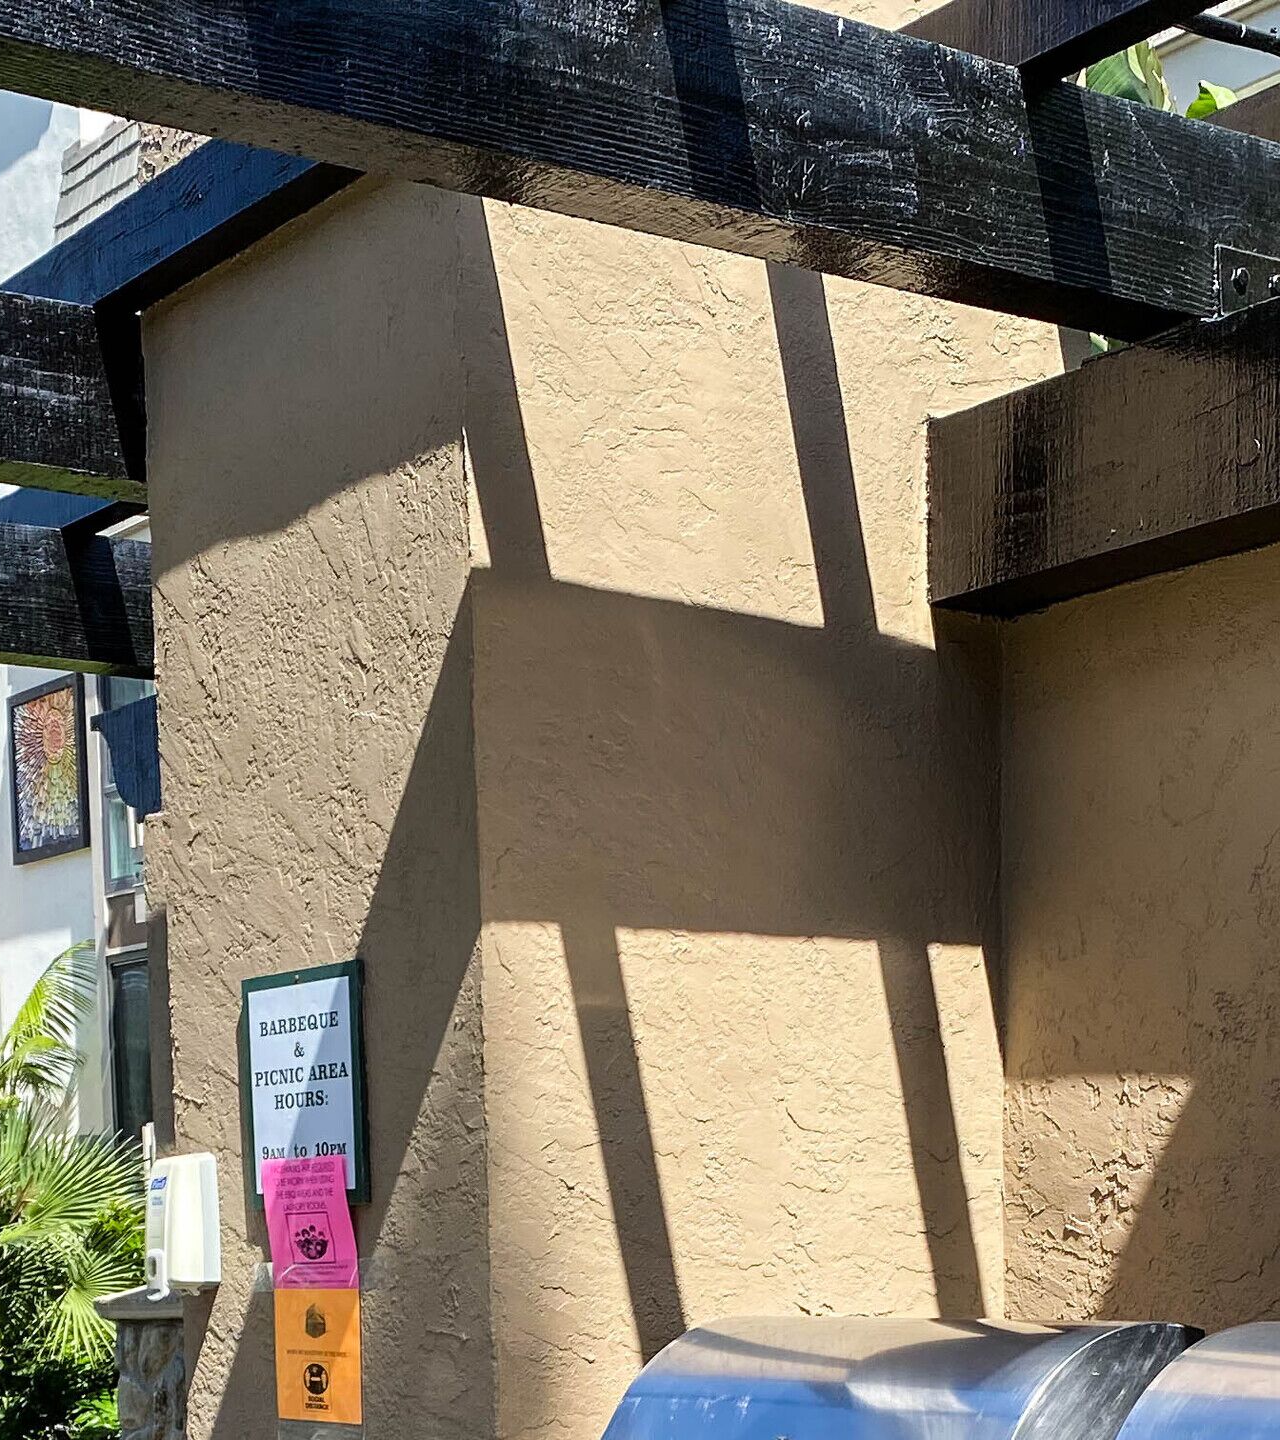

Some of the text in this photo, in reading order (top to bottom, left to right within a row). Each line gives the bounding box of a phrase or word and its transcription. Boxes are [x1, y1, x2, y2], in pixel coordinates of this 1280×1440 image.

[259, 1010, 339, 1037] BARBEQUE
[293, 1041, 305, 1058] &
[255, 1062, 349, 1087] PICNIC AREA
[274, 1090, 329, 1110] HOURS:
[261, 1141, 347, 1160] 9AM to 10PM
